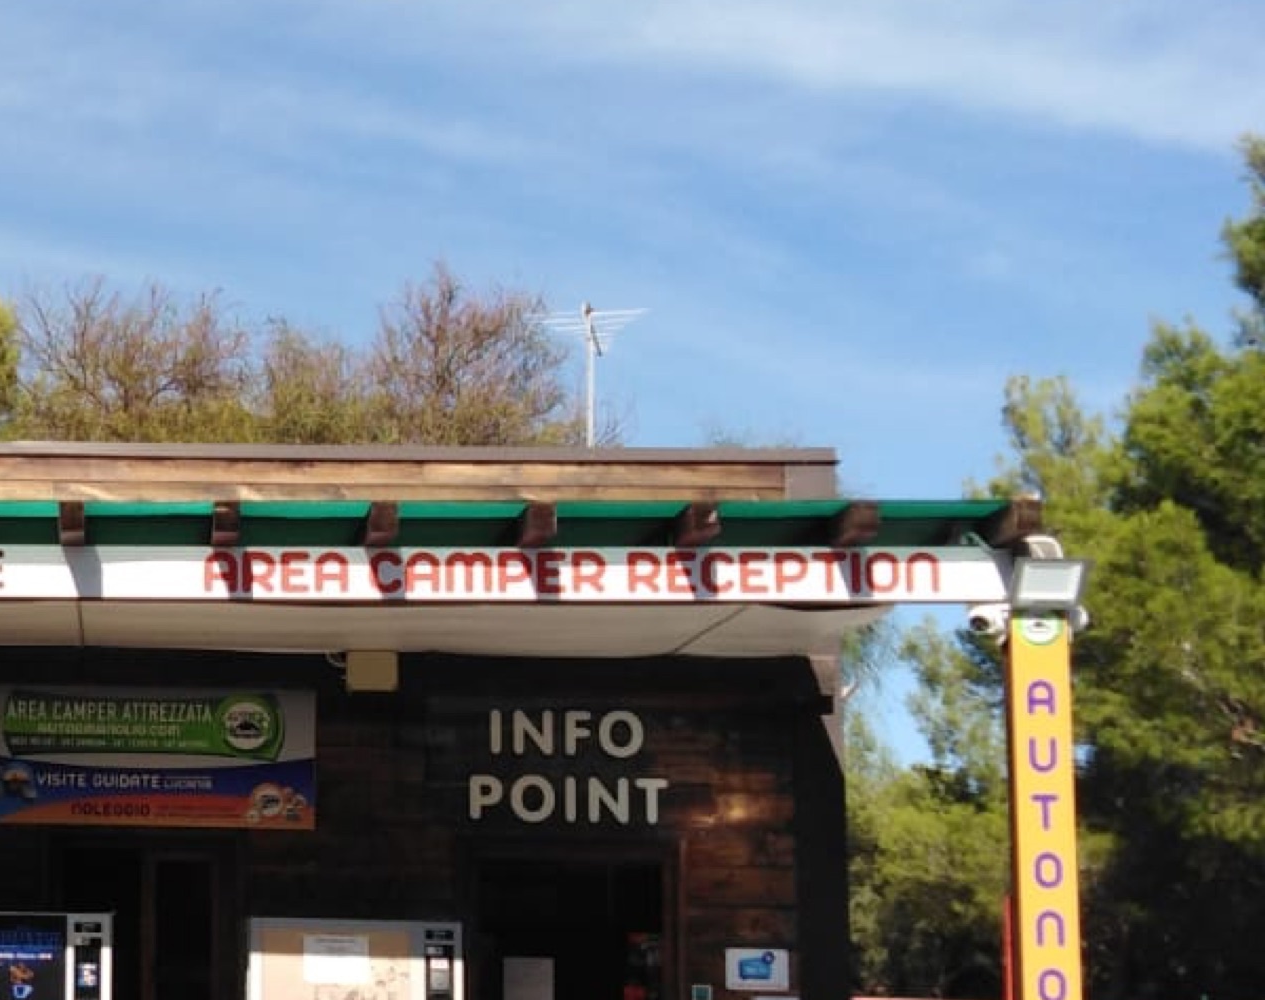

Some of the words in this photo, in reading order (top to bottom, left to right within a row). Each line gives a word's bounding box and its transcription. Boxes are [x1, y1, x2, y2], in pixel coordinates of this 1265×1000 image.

[204, 550, 350, 593] AREA
[368, 551, 606, 594] CAMPER
[627, 552, 941, 595] RECEPTION
[6, 698, 48, 720] AREA
[52, 699, 117, 721] CAMPER
[489, 709, 645, 759] INFO
[37, 772, 87, 789] VISITE
[92, 773, 162, 790] GUIDATE
[468, 773, 670, 826] POINT
